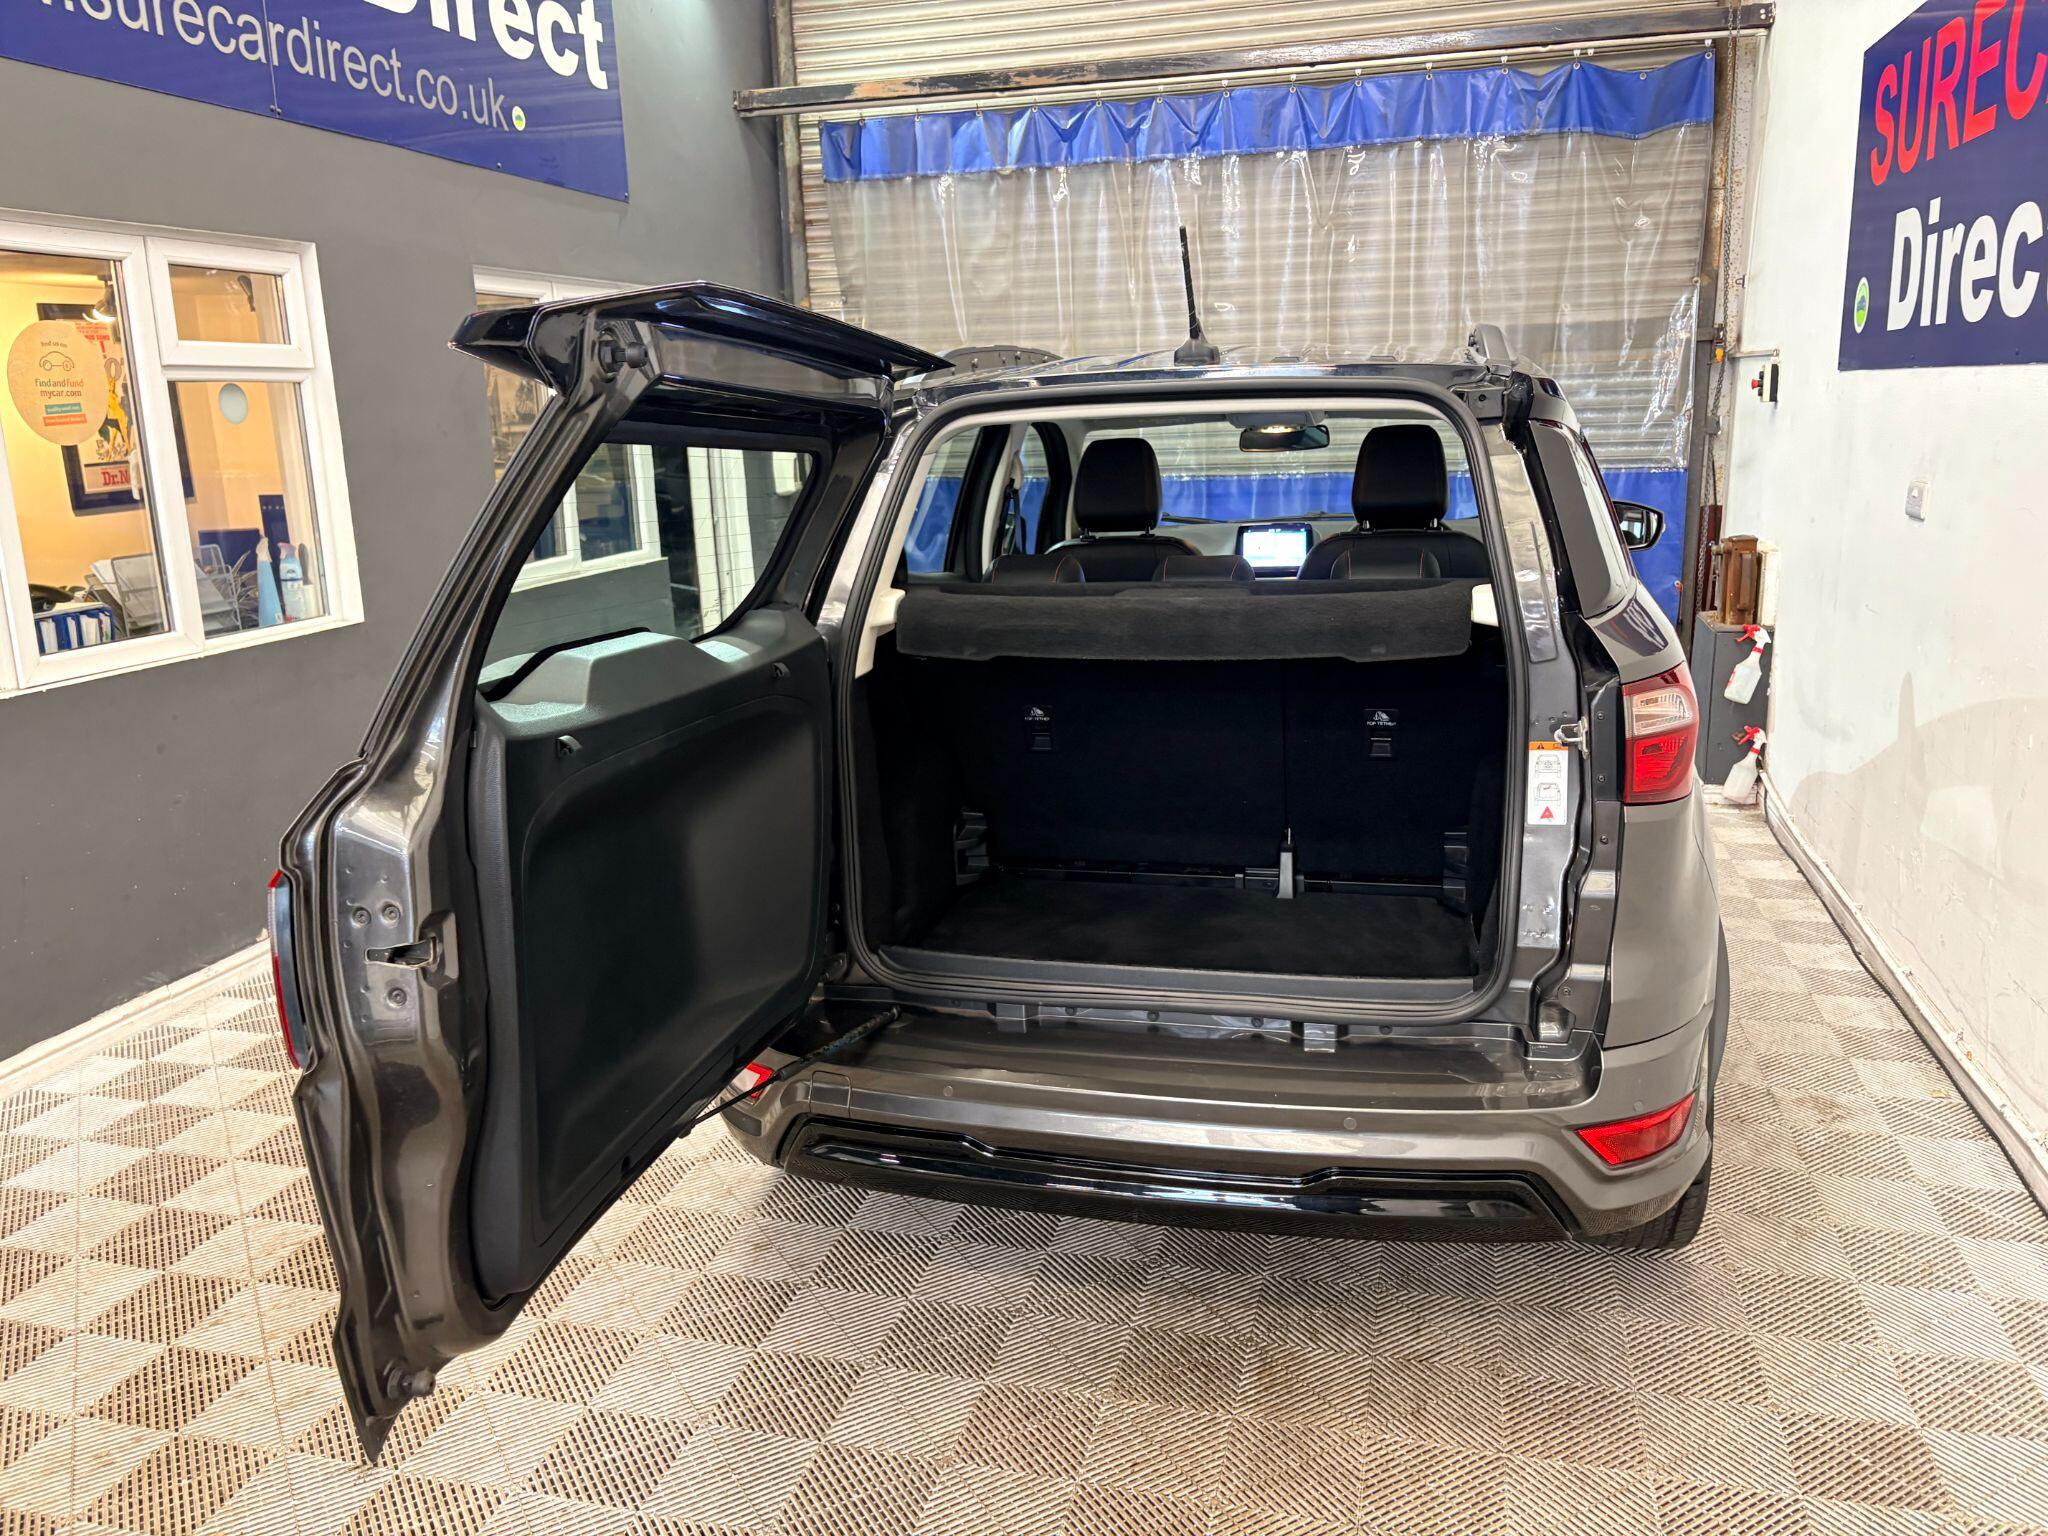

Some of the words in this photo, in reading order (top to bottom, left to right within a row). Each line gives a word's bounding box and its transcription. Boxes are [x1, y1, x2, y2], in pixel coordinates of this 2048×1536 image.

[362, 0, 608, 90] ect
[1870, 0, 2048, 186] SUREC
[1886, 196, 2048, 331] Direc
[101, 468, 131, 486] Dr.N
